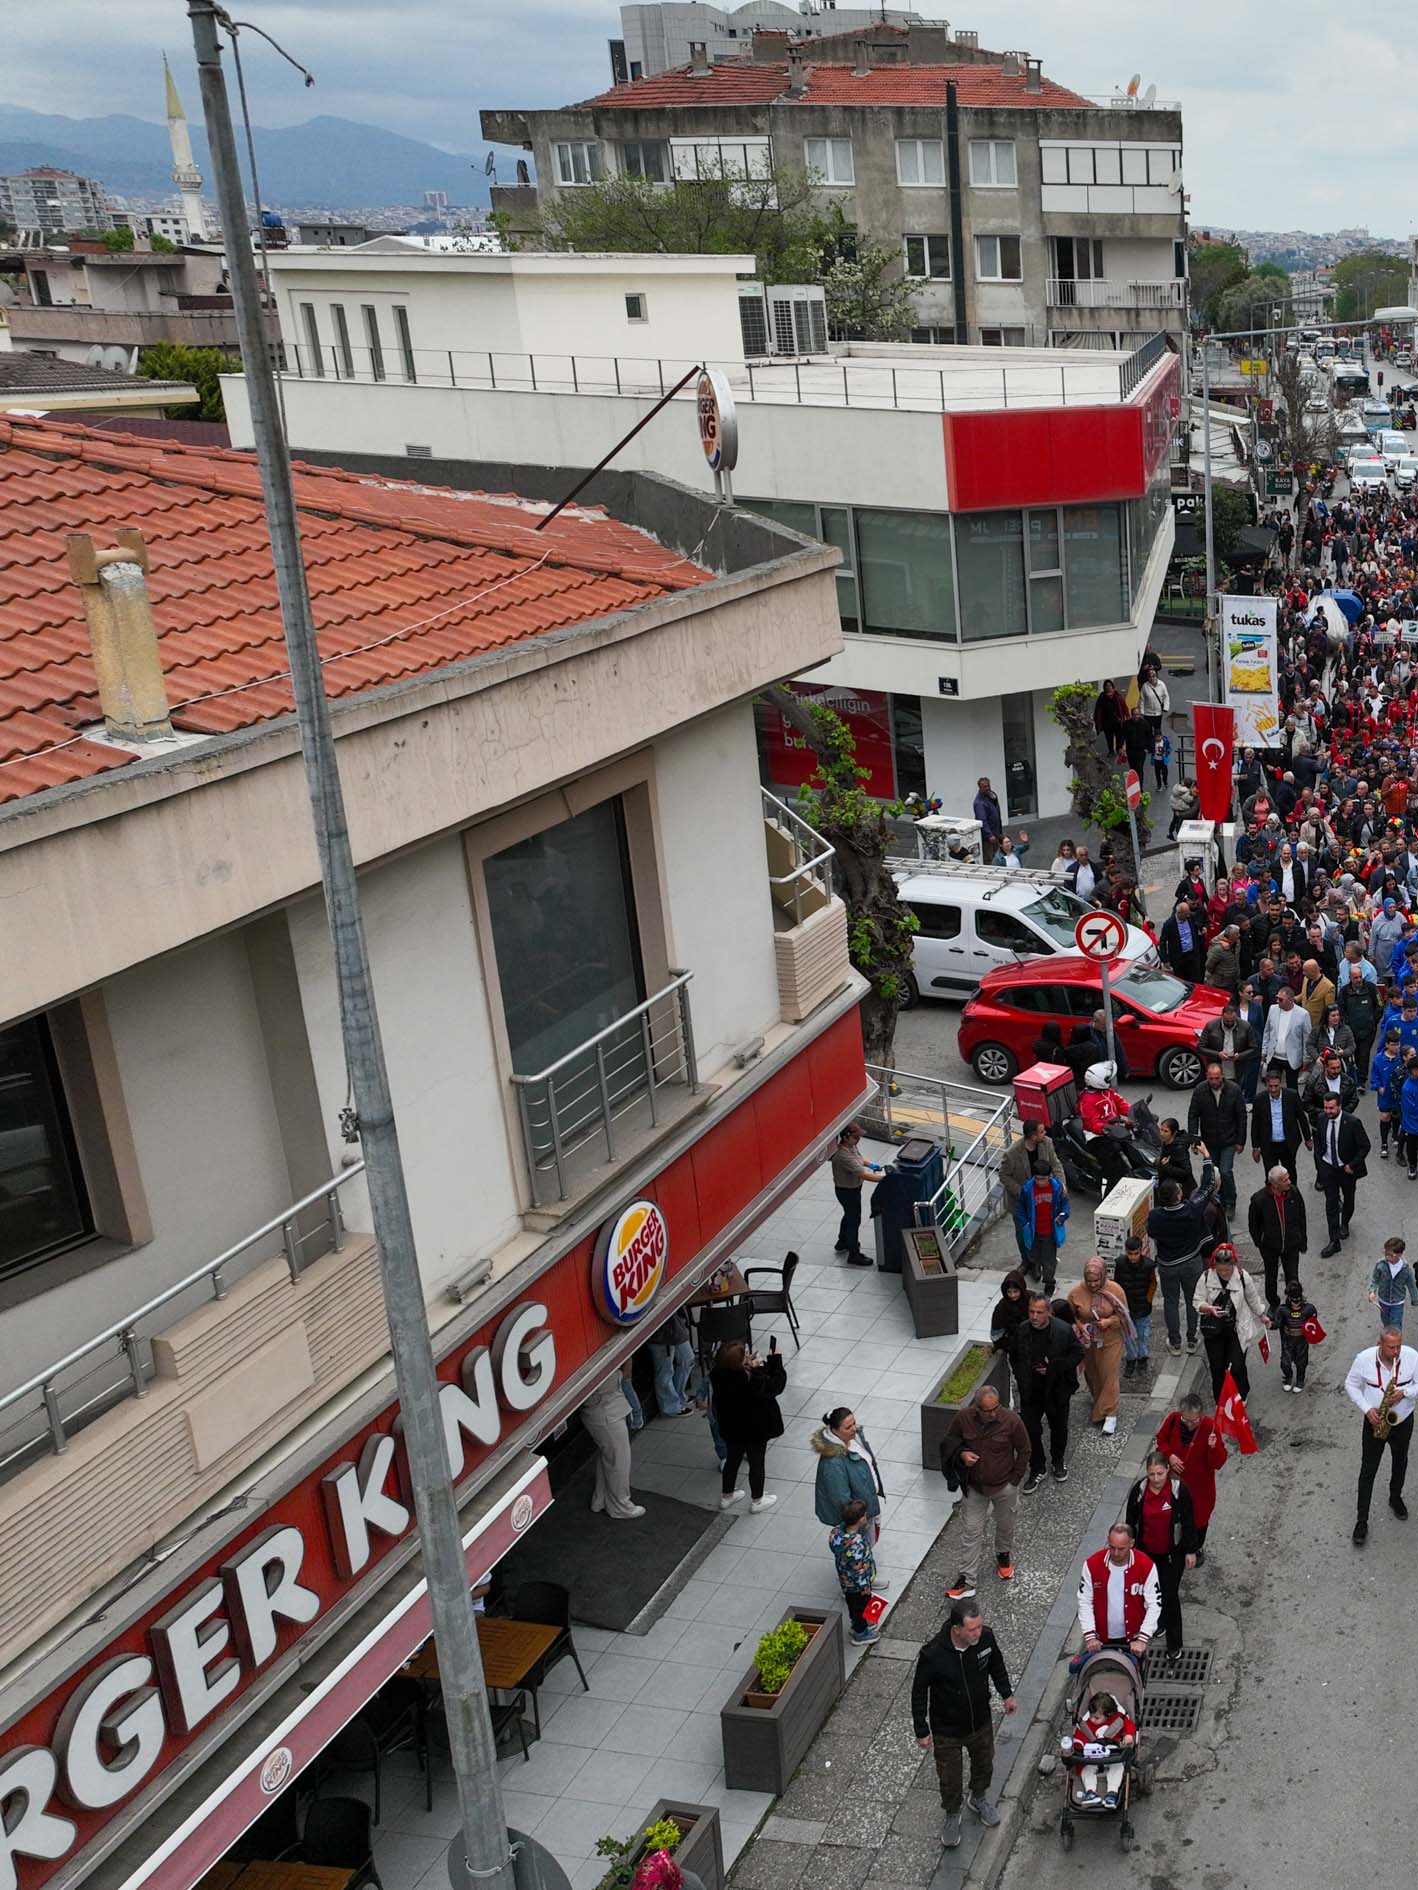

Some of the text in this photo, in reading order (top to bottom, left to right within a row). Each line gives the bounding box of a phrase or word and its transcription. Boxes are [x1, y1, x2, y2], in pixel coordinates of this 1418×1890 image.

[612, 1207, 660, 1290] BURGER
[620, 1223, 665, 1314] KING
[325, 1302, 556, 1576] KNG
